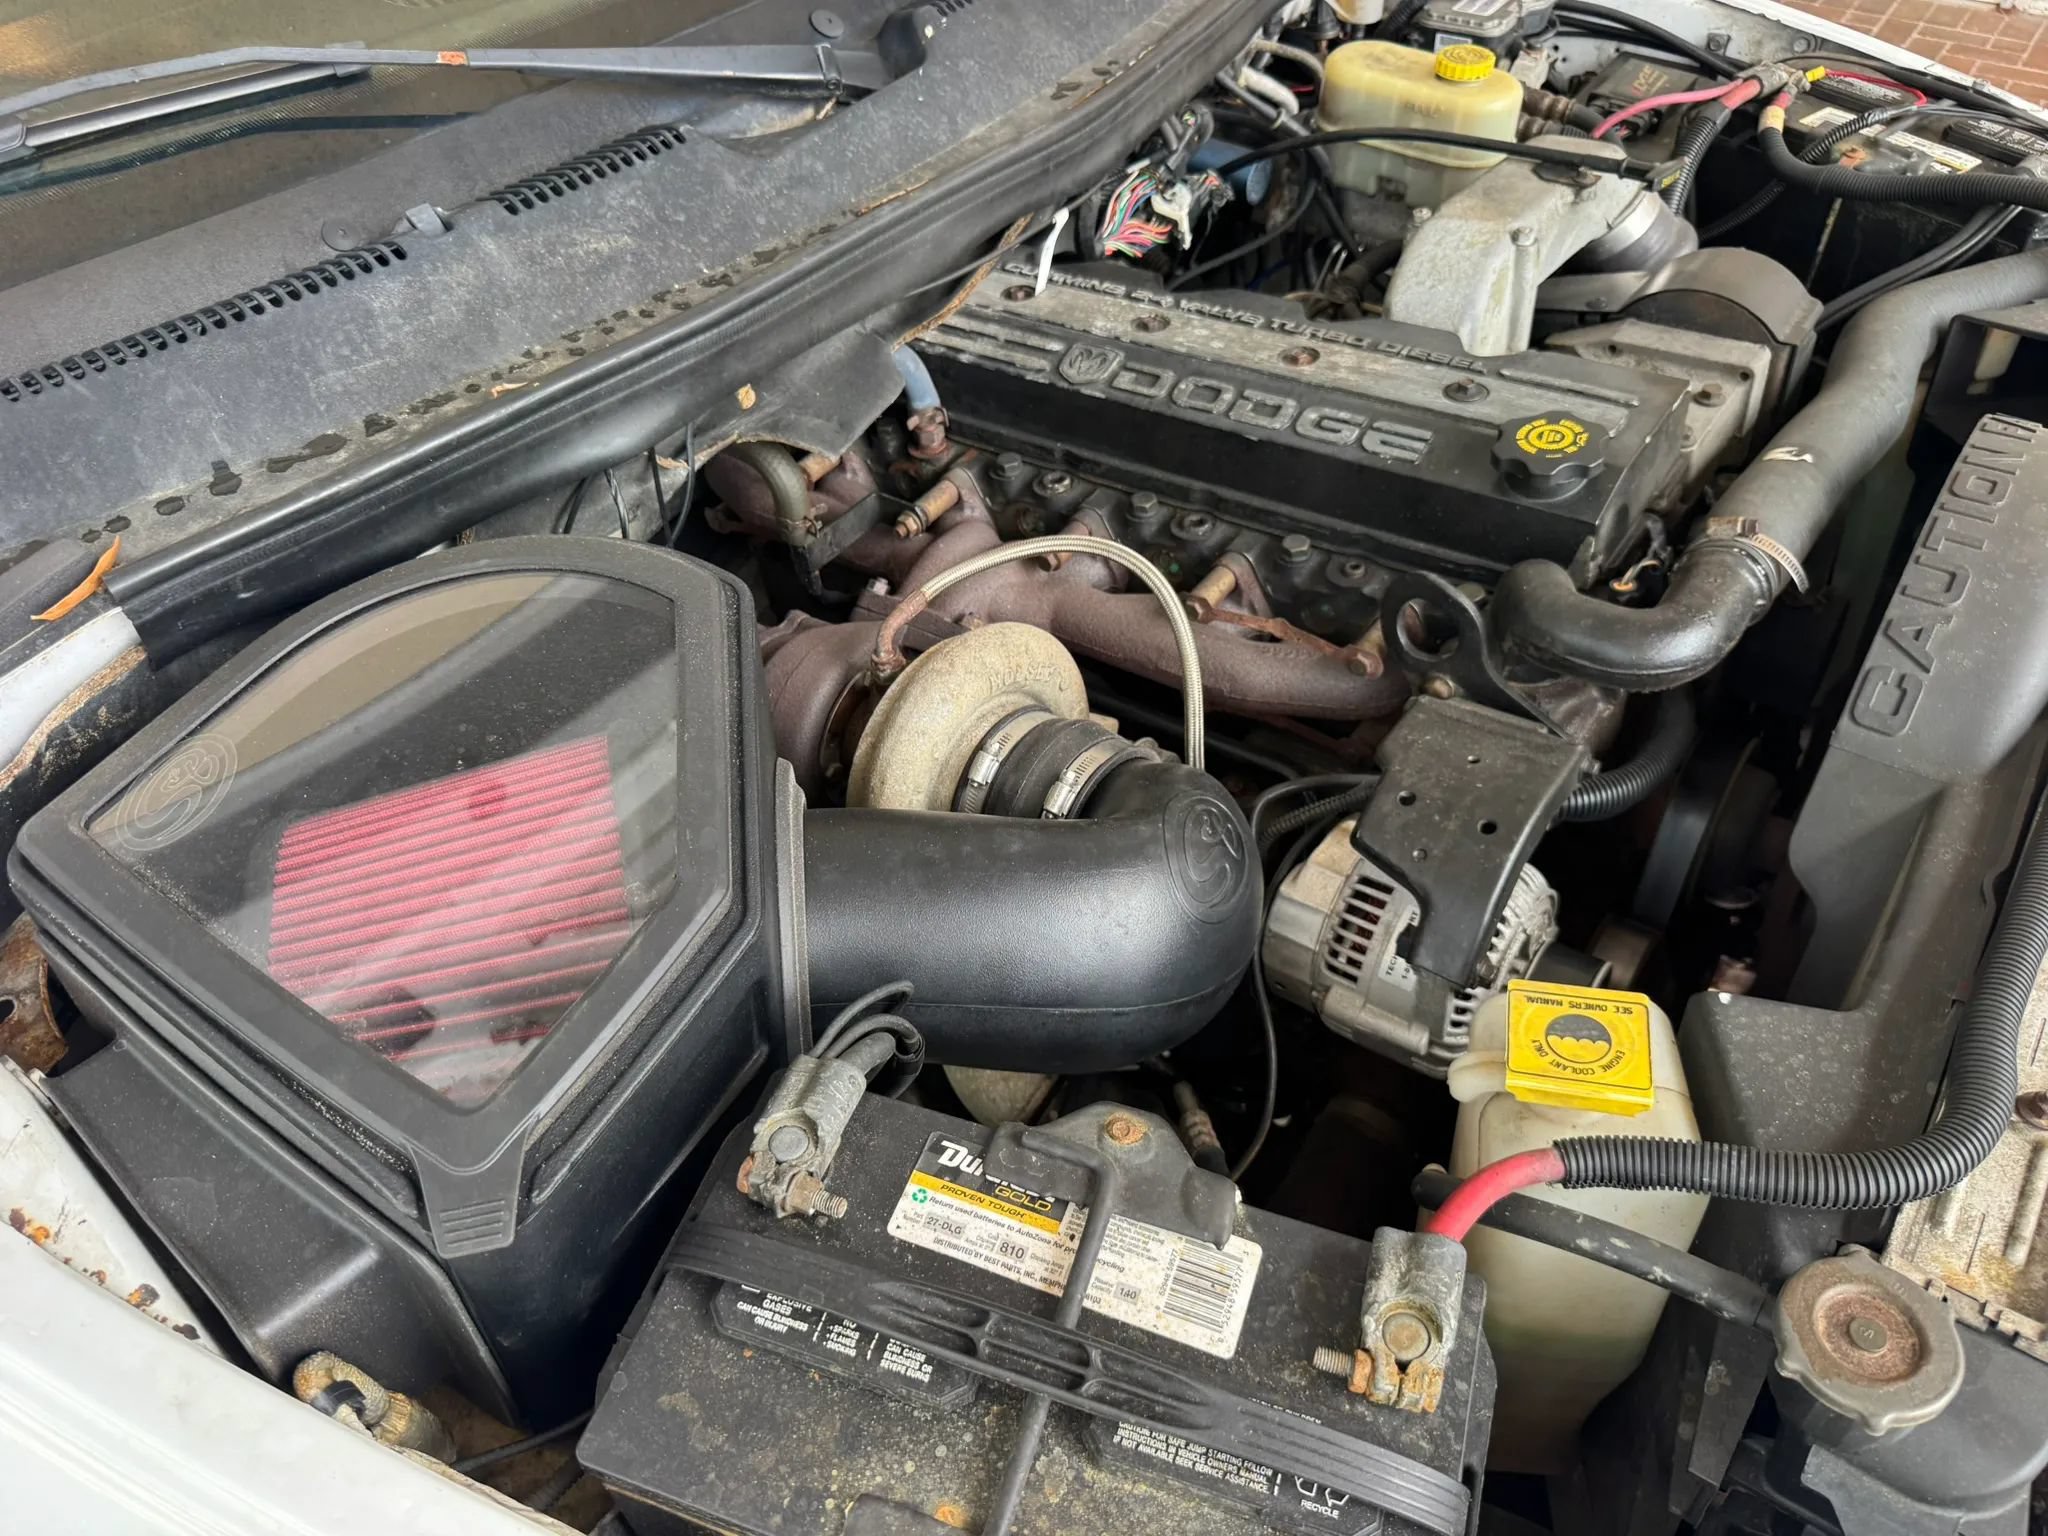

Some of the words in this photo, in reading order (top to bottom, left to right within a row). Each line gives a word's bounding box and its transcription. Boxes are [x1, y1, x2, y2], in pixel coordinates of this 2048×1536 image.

[1271, 318, 1371, 348] TURBO
[1377, 341, 1487, 375] DIESEL
[1109, 361, 1433, 464] DODGE
[1850, 444, 2026, 737] CAUTION
[1524, 995, 1563, 1008] MANUAL
[1568, 1000, 1608, 1013] OWNERS
[1613, 1005, 1633, 1015] SEE
[1531, 1038, 1549, 1058] ONLY
[1549, 1058, 1596, 1076] COOLANT
[1601, 1049, 1626, 1073] ENGINE
[940, 1184, 985, 1204] PROVEN
[988, 1201, 1026, 1219] TOUGH
[994, 1185, 1052, 1212] GOLD
[928, 1196, 954, 1210] Return
[954, 1204, 973, 1216] used
[973, 1211, 1007, 1229] batteries
[1006, 1222, 1015, 1232] to
[1052, 1240, 1065, 1249] for
[999, 1241, 1025, 1260] 810
[933, 1237, 974, 1257] DISTRIBUTED
[974, 1250, 983, 1260] BY
[984, 1254, 1000, 1267] BEST
[1038, 1271, 1065, 1290] MEMPH
[762, 1299, 793, 1316] GASES
[883, 1350, 921, 1371] BLINDNESS
[921, 1363, 934, 1375] OR
[886, 1343, 902, 1354] CAN
[903, 1348, 927, 1364] CAUSE
[880, 1358, 907, 1375] SEVERE
[906, 1368, 931, 1384] BURNS
[1117, 1427, 1167, 1450] INSTRUCTIONS
[1177, 1448, 1207, 1465] VEHICLE
[1207, 1458, 1239, 1474] OWNERS
[1121, 1438, 1138, 1450] NOT
[1174, 1455, 1194, 1469] SEEK
[1194, 1463, 1224, 1479] SERVICE
[1167, 1435, 1187, 1449] SAFE
[1187, 1442, 1207, 1454] JUMP
[1207, 1448, 1243, 1467] STARTING
[1243, 1460, 1273, 1477] FOLLOW
[1301, 1499, 1340, 1518] RECYCLE
